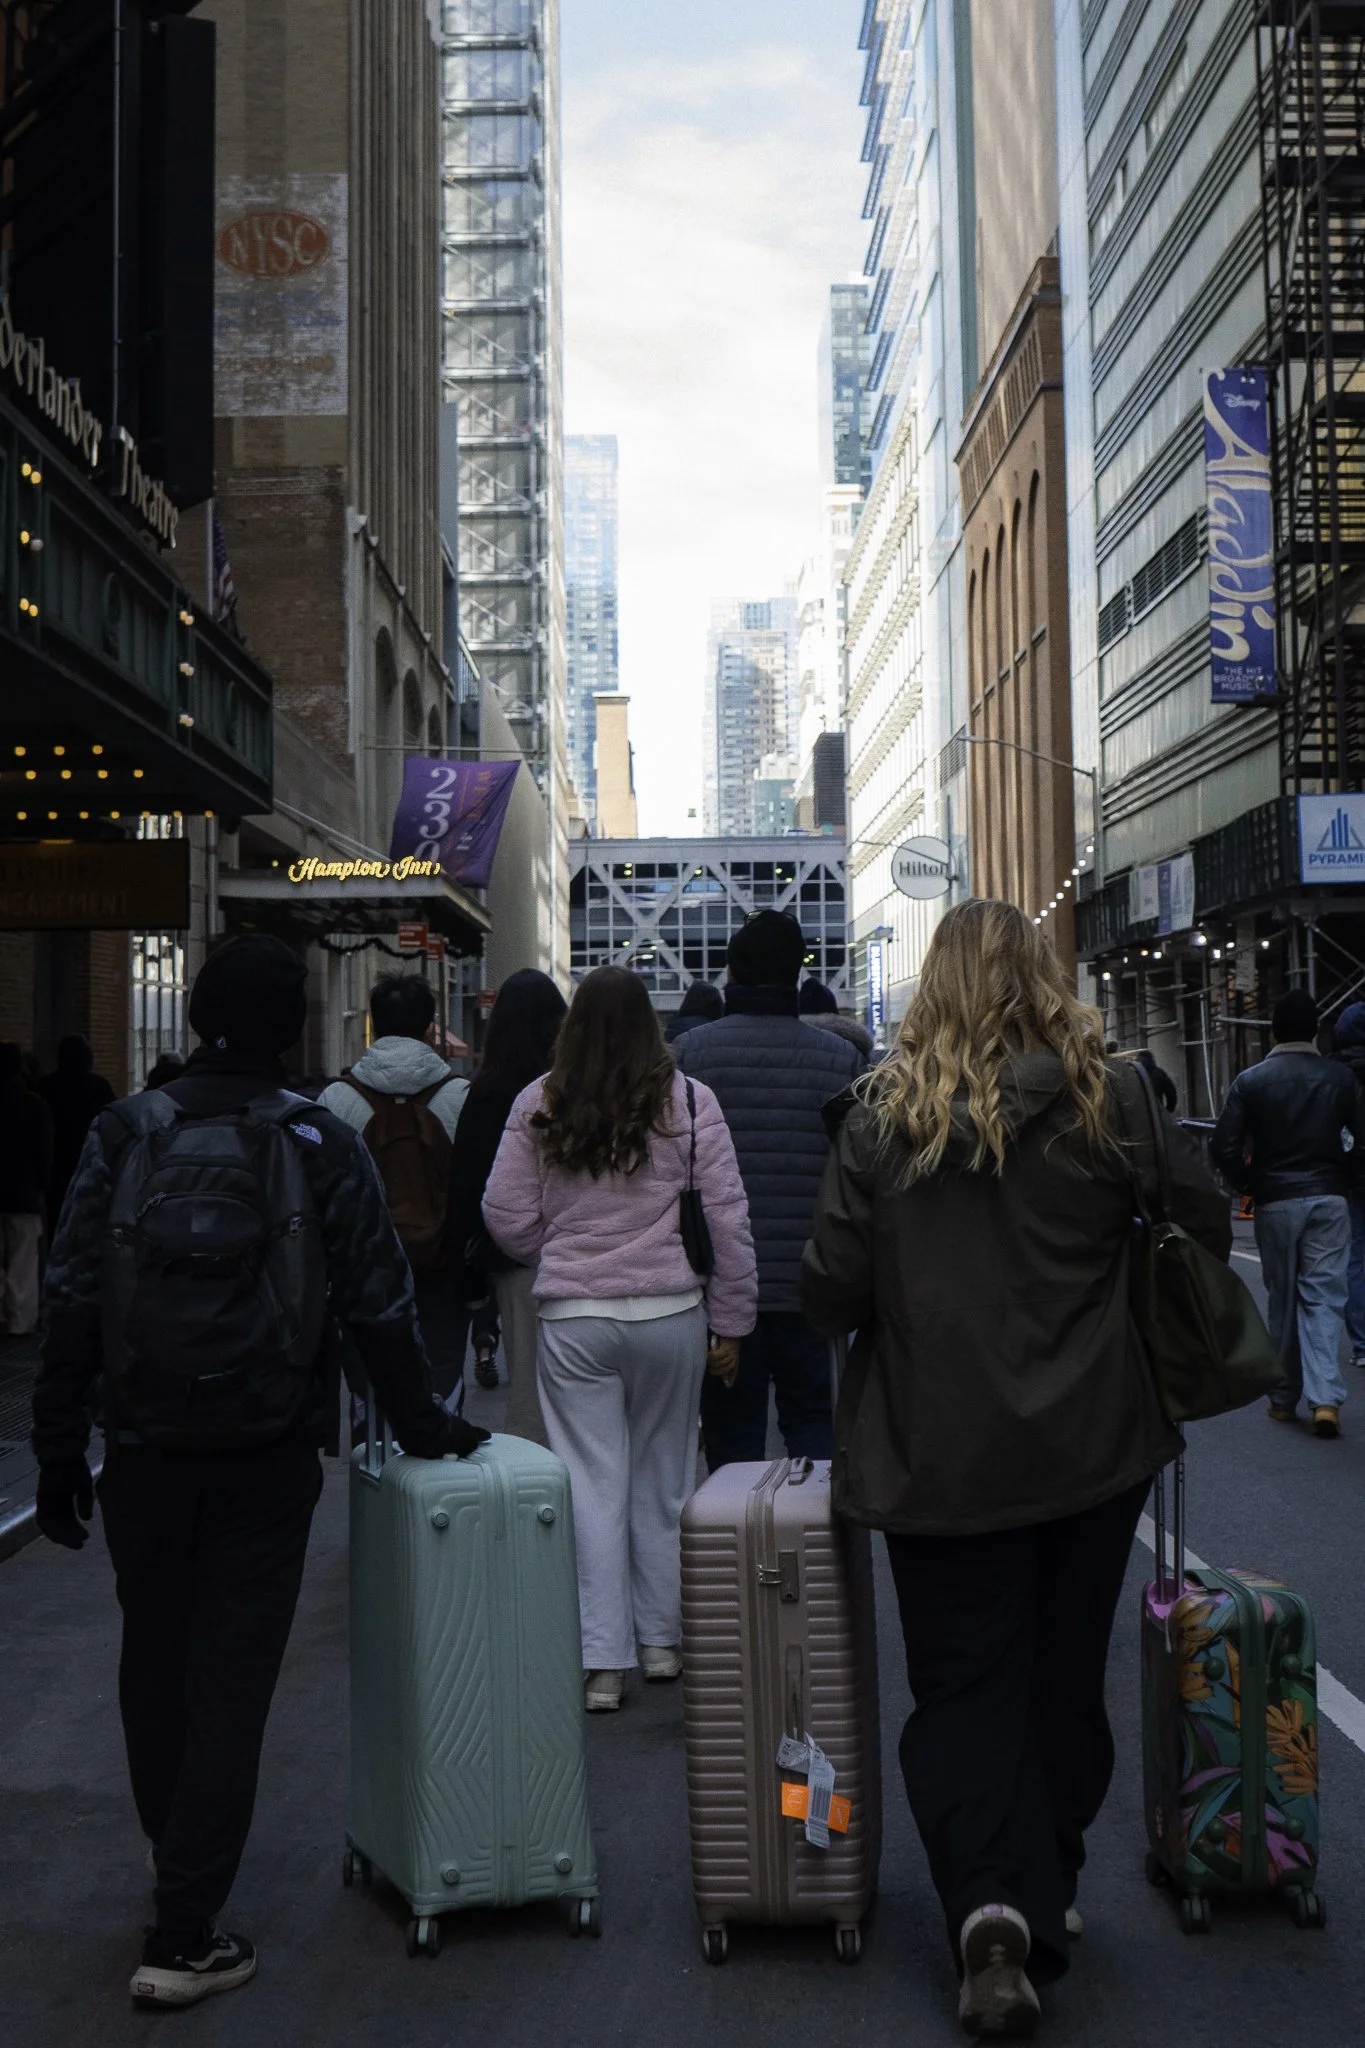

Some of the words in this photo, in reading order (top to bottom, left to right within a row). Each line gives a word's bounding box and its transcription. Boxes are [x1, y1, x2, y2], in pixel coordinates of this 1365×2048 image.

[229, 215, 317, 274] NYSC
[1202, 367, 1275, 662] Aladdin
[1213, 673, 1273, 684] BROADY
[1224, 666, 1243, 675] THE
[1246, 665, 1263, 675] HIT
[288, 856, 391, 883] Hampton
[392, 855, 441, 881] Inn
[1309, 853, 1365, 865] PYRAMI
